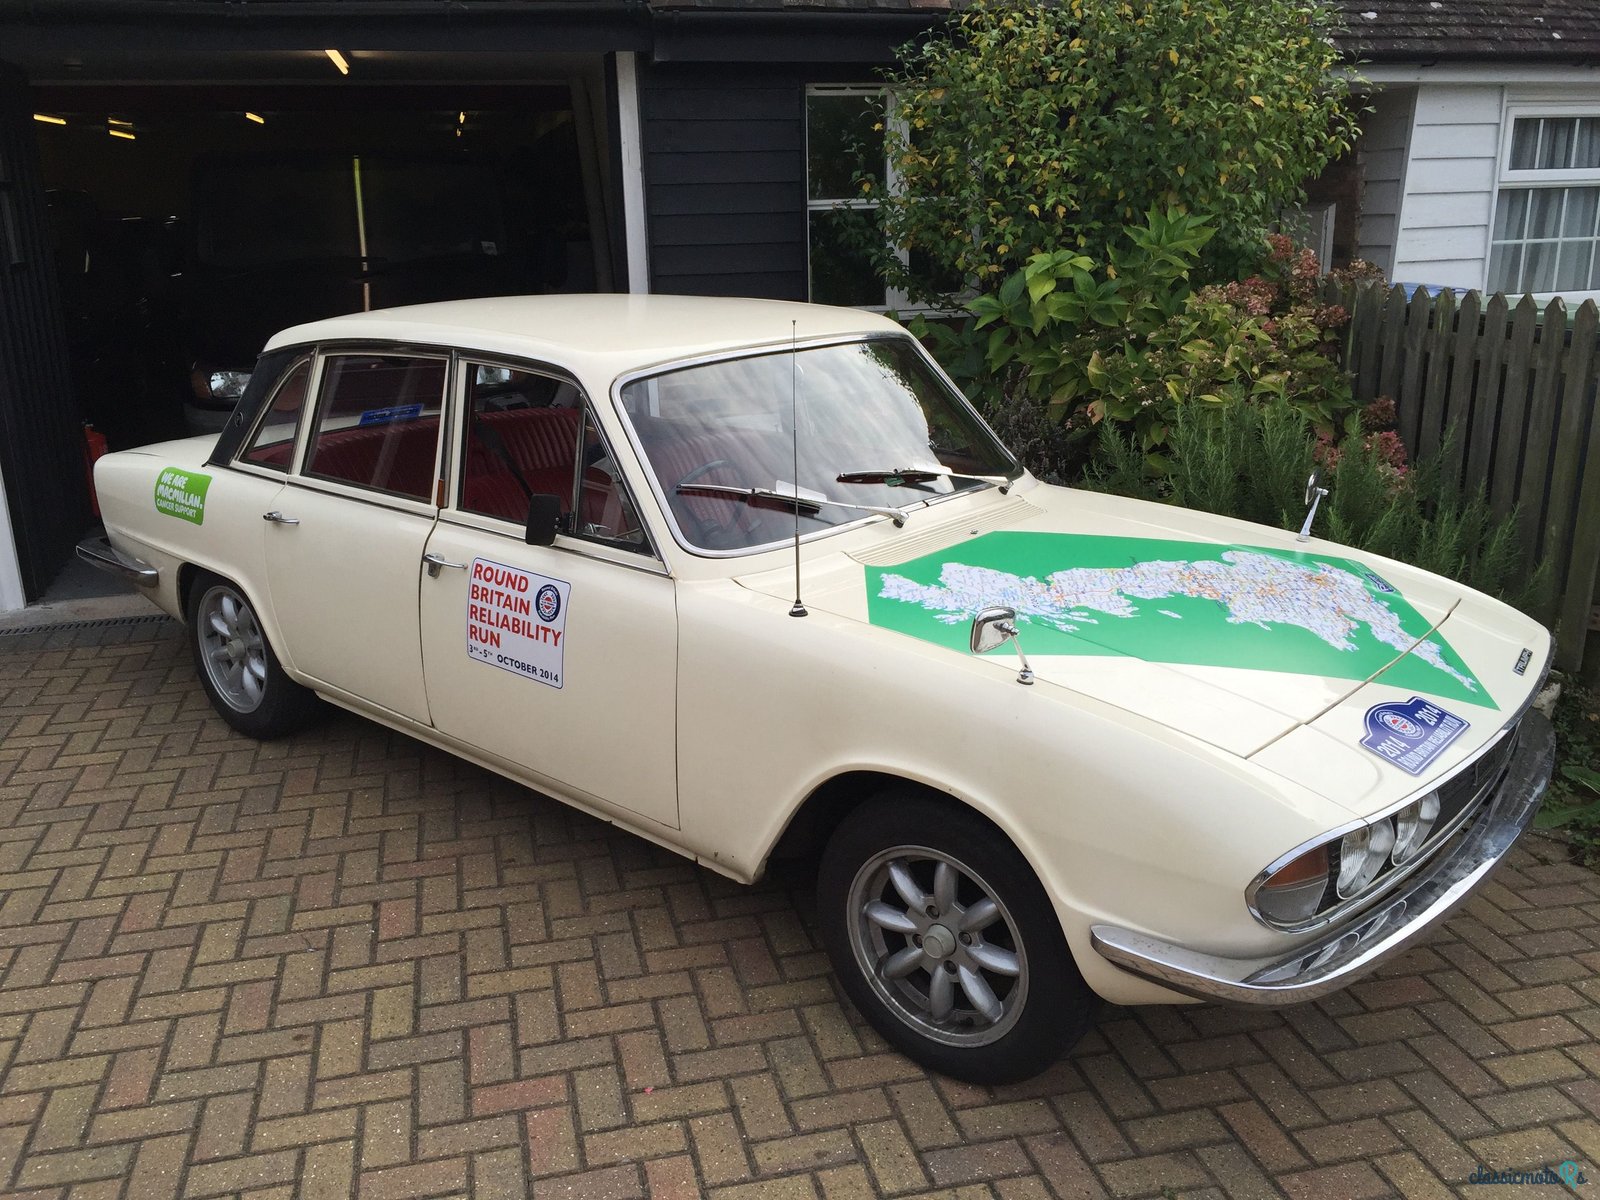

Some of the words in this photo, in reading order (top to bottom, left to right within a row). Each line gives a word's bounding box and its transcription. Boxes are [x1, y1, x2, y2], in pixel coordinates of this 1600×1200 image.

[161, 472, 174, 485] WE
[172, 475, 188, 489] ARE
[473, 563, 529, 593] ROUND
[471, 584, 530, 616] BRITAIN
[470, 605, 562, 647] RELIABILITY
[470, 625, 500, 648] RUN
[497, 654, 538, 675] OCTOBER
[540, 669, 559, 682] 2014
[1414, 704, 1442, 726] 2014
[1376, 736, 1411, 758] 2014
